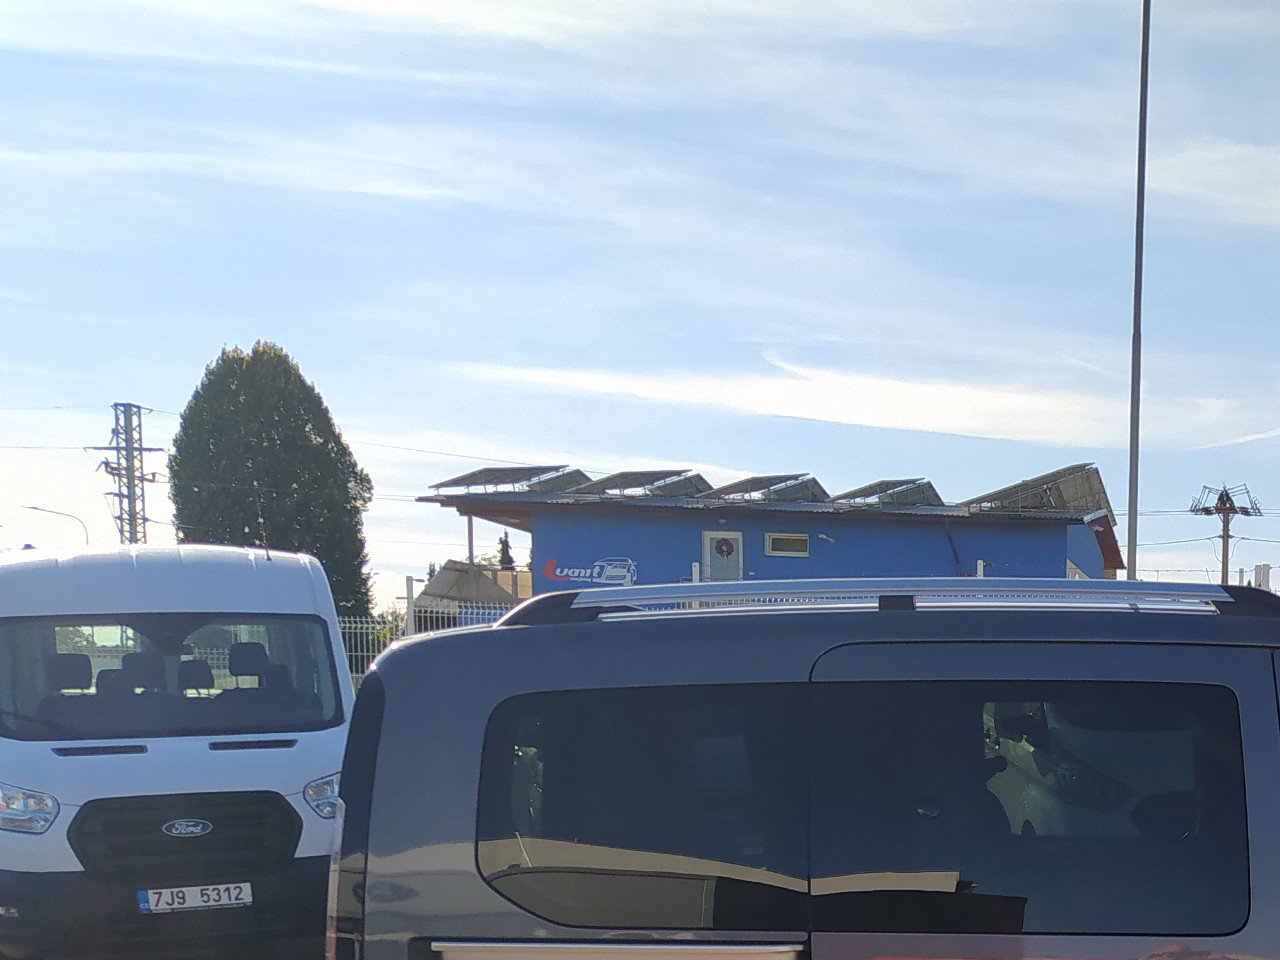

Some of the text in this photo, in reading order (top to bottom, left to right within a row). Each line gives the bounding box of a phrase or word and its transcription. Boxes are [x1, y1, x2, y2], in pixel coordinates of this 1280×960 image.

[171, 821, 204, 834] Ford
[152, 889, 187, 908] 7J9
[200, 885, 245, 904] 5312
